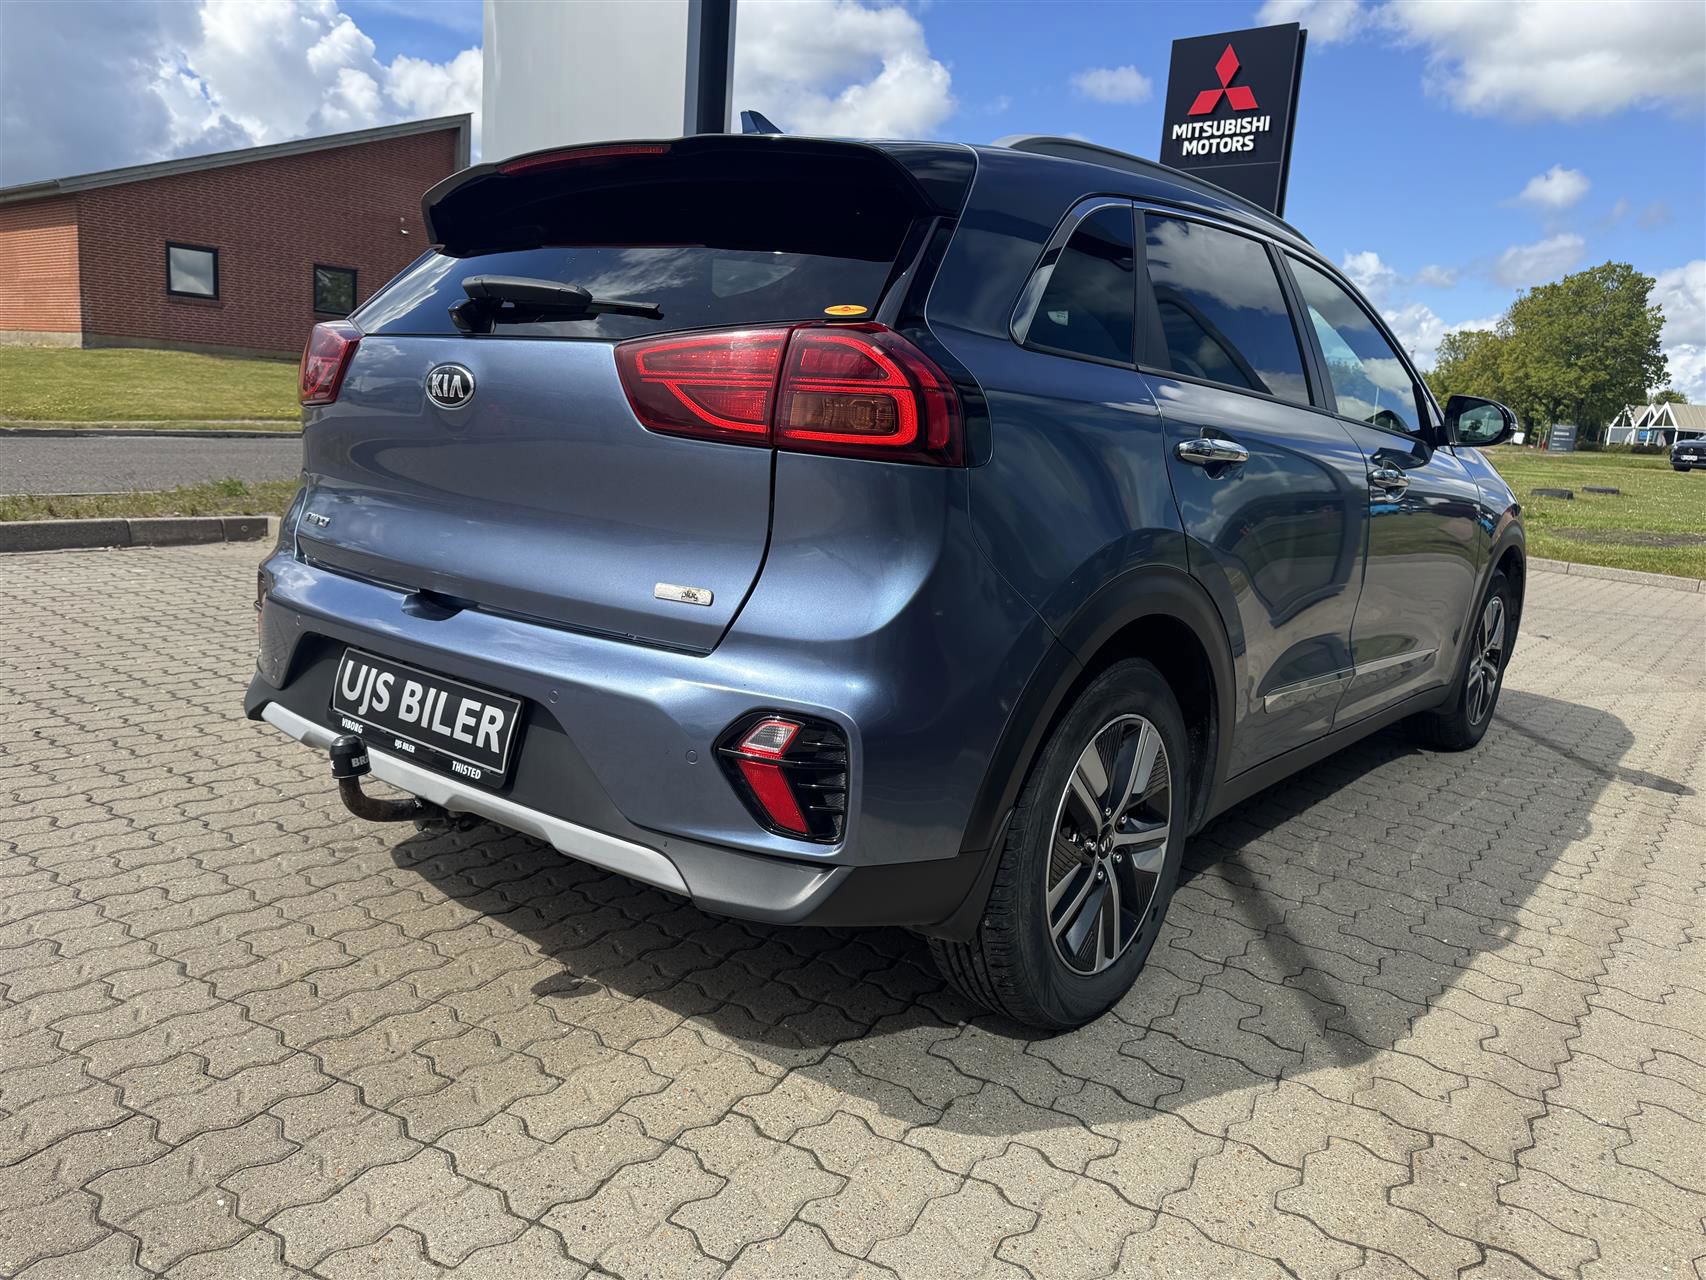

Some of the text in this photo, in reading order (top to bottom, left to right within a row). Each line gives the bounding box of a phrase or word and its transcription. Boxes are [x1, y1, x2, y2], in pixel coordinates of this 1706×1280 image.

[1172, 115, 1270, 139] MITSUBISHI
[1182, 135, 1254, 156] MOTORS
[432, 374, 463, 398] KIA
[341, 660, 505, 754] UJS BILER
[341, 717, 363, 734] VIBORG
[394, 739, 415, 754] UJS BILER
[451, 760, 481, 780] THISTED
